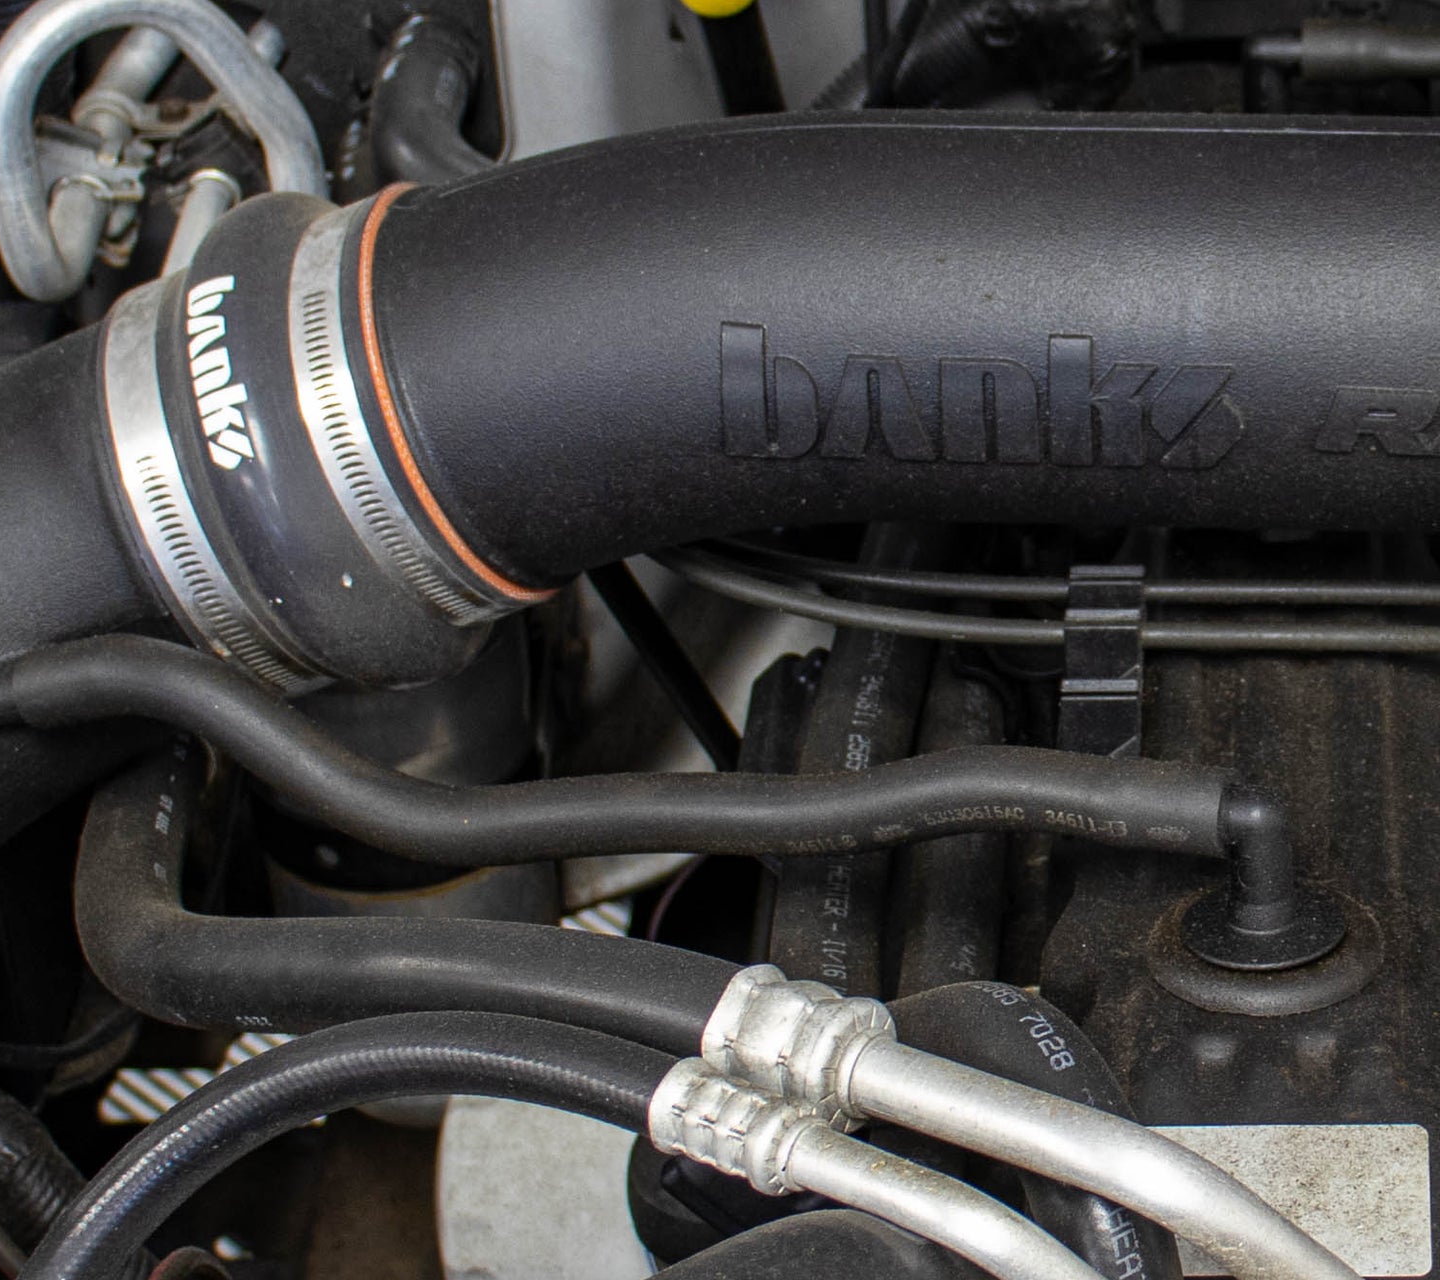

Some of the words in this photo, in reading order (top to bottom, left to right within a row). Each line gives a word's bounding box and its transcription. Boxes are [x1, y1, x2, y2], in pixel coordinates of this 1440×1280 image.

[187, 274, 254, 470] banks
[719, 321, 1244, 470] banks
[1018, 1010, 1075, 1073] 7028
